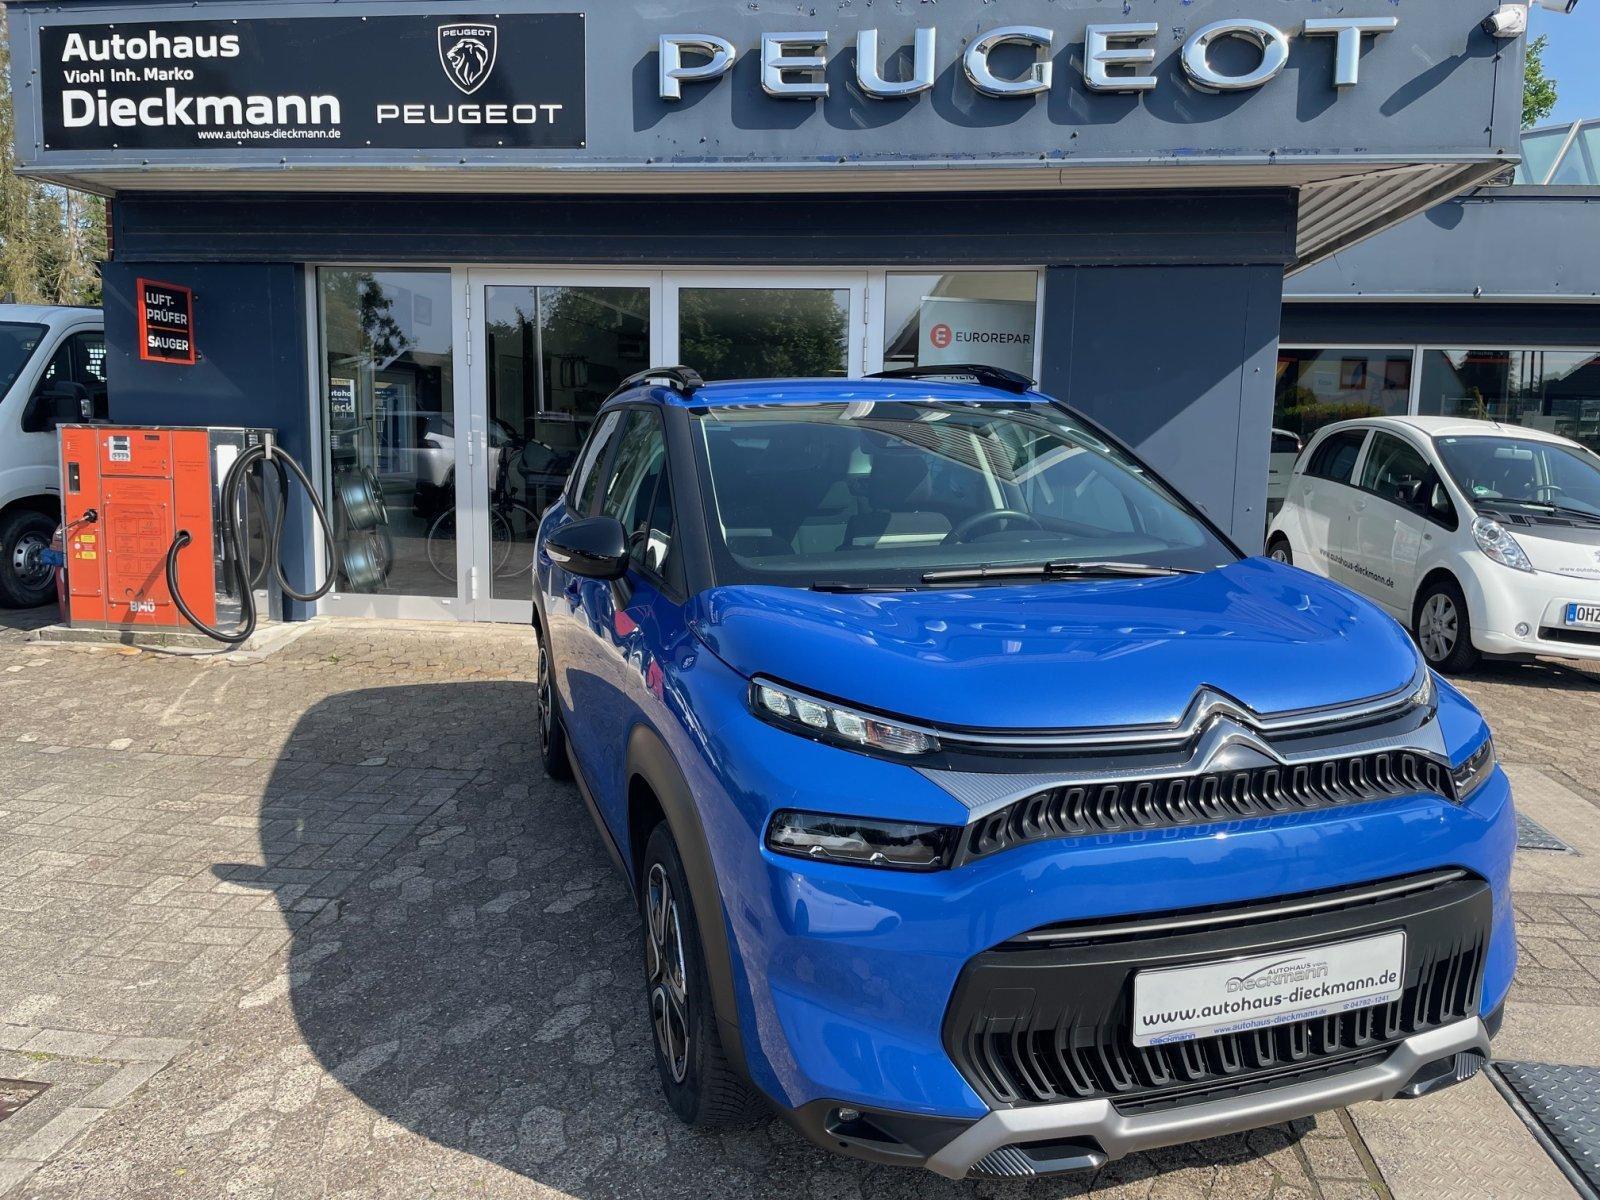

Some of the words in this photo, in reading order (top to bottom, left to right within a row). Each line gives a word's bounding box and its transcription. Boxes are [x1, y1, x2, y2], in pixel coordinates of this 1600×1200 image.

[442, 29, 492, 37] PEUGEOT
[61, 30, 241, 62] Autohaus
[659, 16, 1398, 101] PEUGEOT
[63, 69, 105, 83] Viohl
[110, 68, 141, 82] Inh.
[144, 67, 194, 81] Marko
[61, 87, 341, 128] Dieckmann
[376, 104, 563, 124] PEUGEOT
[197, 128, 341, 139] www.autohaus-dieckmann.de
[145, 292, 175, 307] LUFT-
[146, 308, 188, 325] PRÜFER
[147, 335, 189, 351] SAUGER
[955, 331, 1031, 344] EUROREPAR
[1319, 548, 1394, 589] www.autohaus-dieckmann.de
[1267, 962, 1311, 975] AUTOHAUS
[1142, 969, 1397, 1026] www.autohaus-dieckmann.de
[1213, 1008, 1327, 1034] www.autohaus-dieckmann.de
